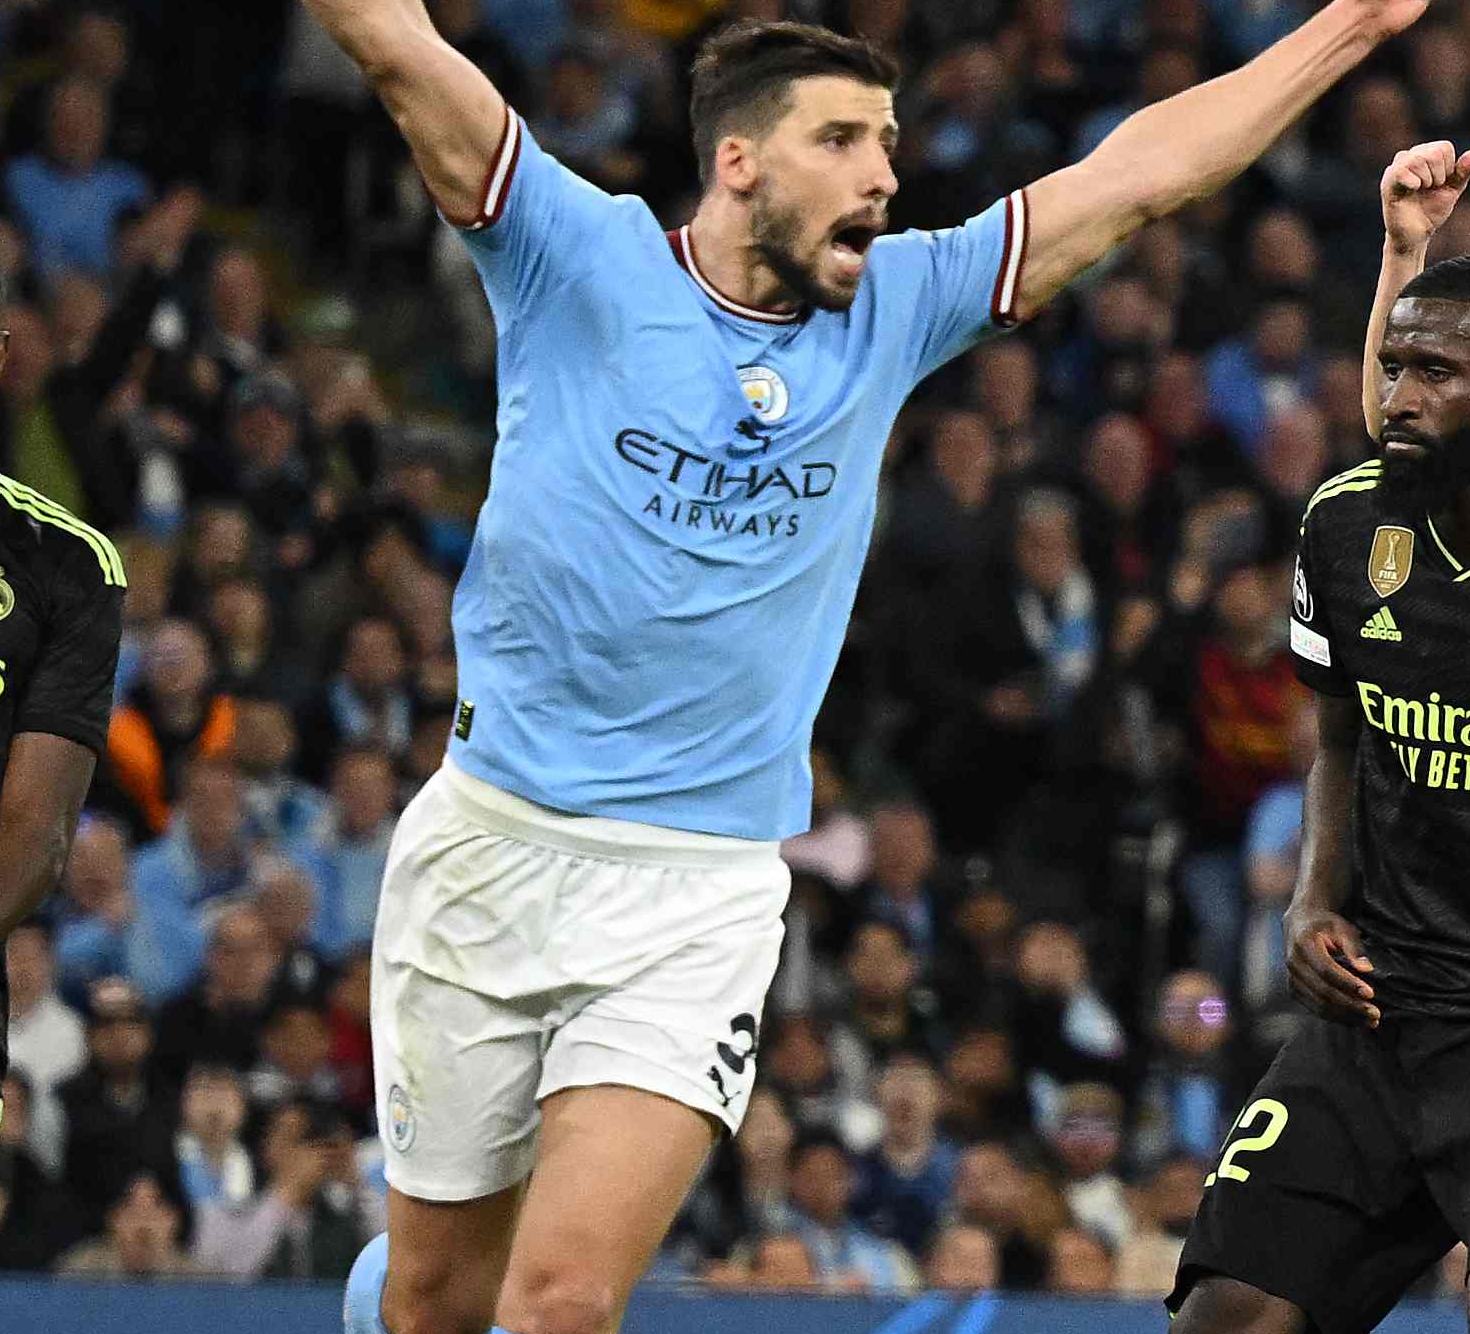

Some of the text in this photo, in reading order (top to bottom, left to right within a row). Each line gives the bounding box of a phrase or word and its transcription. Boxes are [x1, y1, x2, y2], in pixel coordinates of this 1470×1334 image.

[615, 428, 837, 499] ETIHAD
[643, 493, 800, 537] AIRWAYS
[1378, 570, 1398, 580] FIFA
[1360, 626, 1403, 643] adidas
